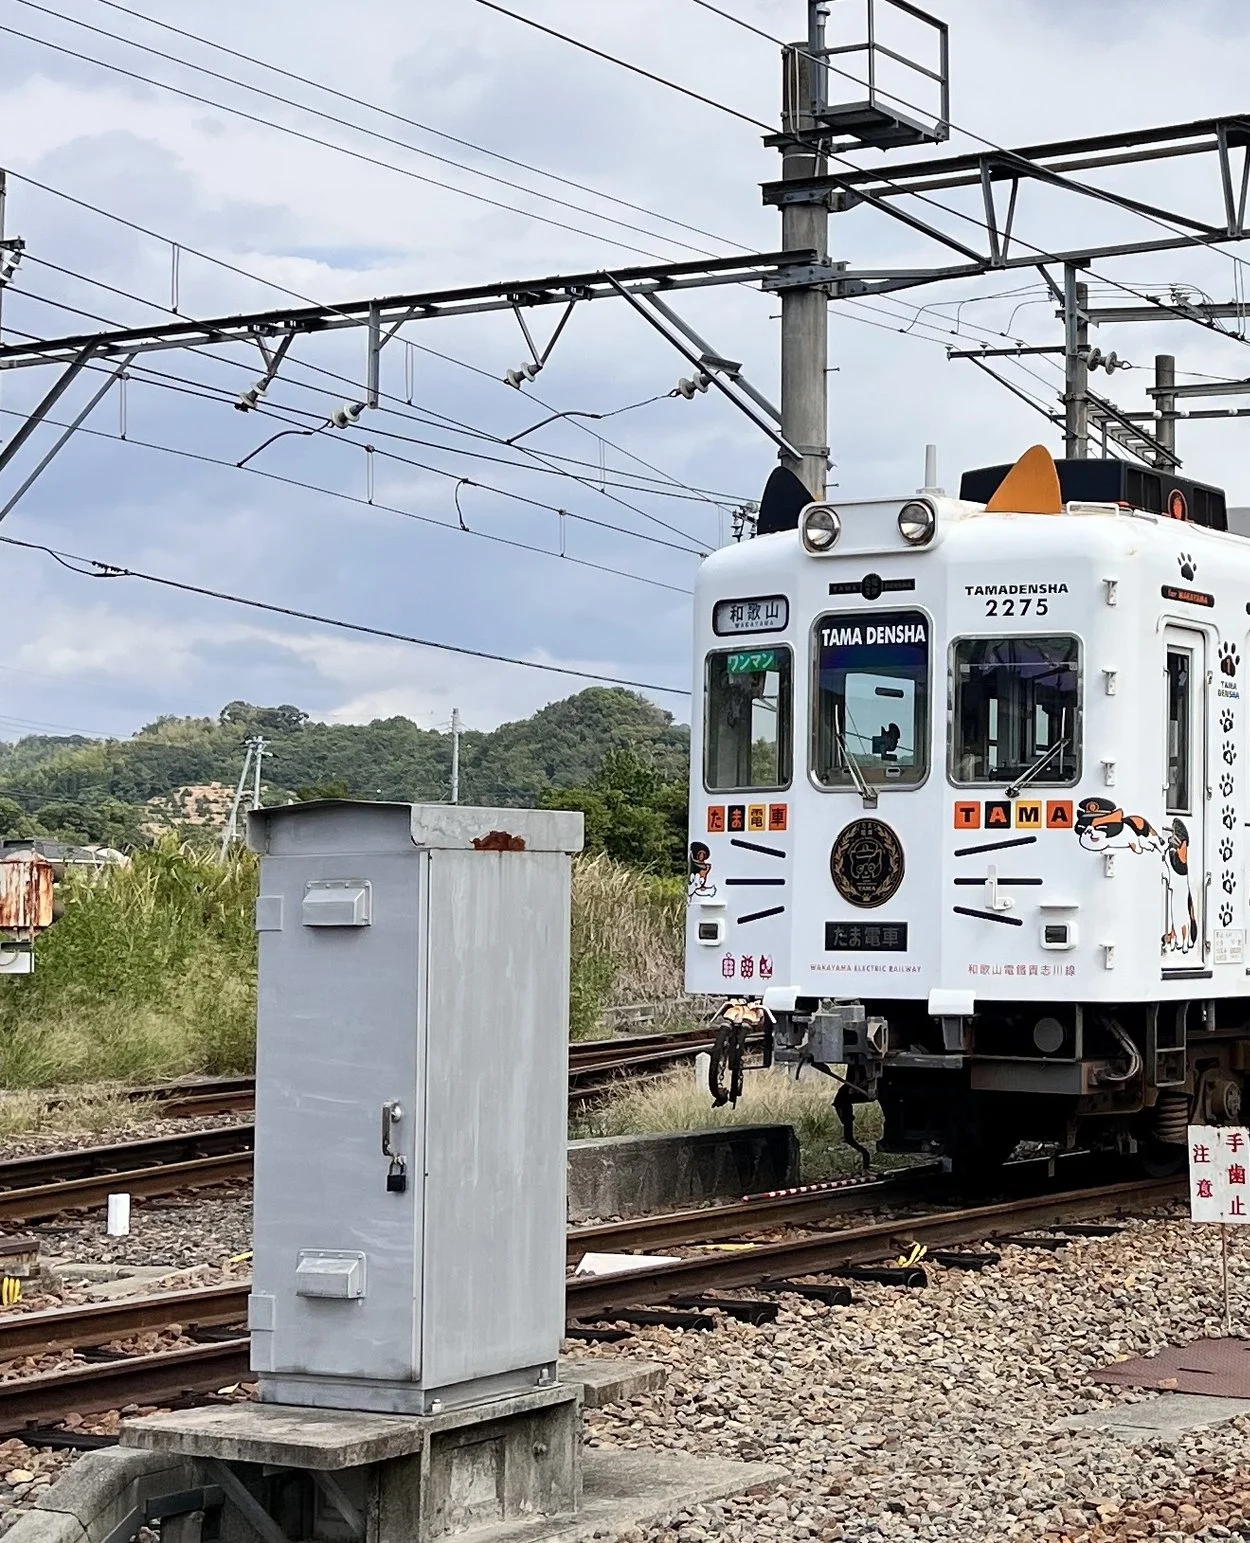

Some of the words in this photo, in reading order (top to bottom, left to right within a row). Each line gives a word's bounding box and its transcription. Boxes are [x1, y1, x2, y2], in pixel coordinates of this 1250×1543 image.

[964, 583, 1069, 596] TAMADENSHA
[730, 602, 780, 623] 和歌山
[985, 598, 1048, 617] 2275
[822, 627, 863, 647] TAMA
[866, 624, 926, 645] DENSHA
[728, 653, 774, 672] ワンマン
[709, 806, 786, 829] たま電車
[959, 806, 1069, 823] TAMA
[833, 926, 899, 947] たま電車
[810, 963, 851, 972] WAKAYAMA
[854, 964, 886, 973] ELECTRIC
[889, 964, 922, 973] RAILWAY
[1192, 1143, 1214, 1198] 注意
